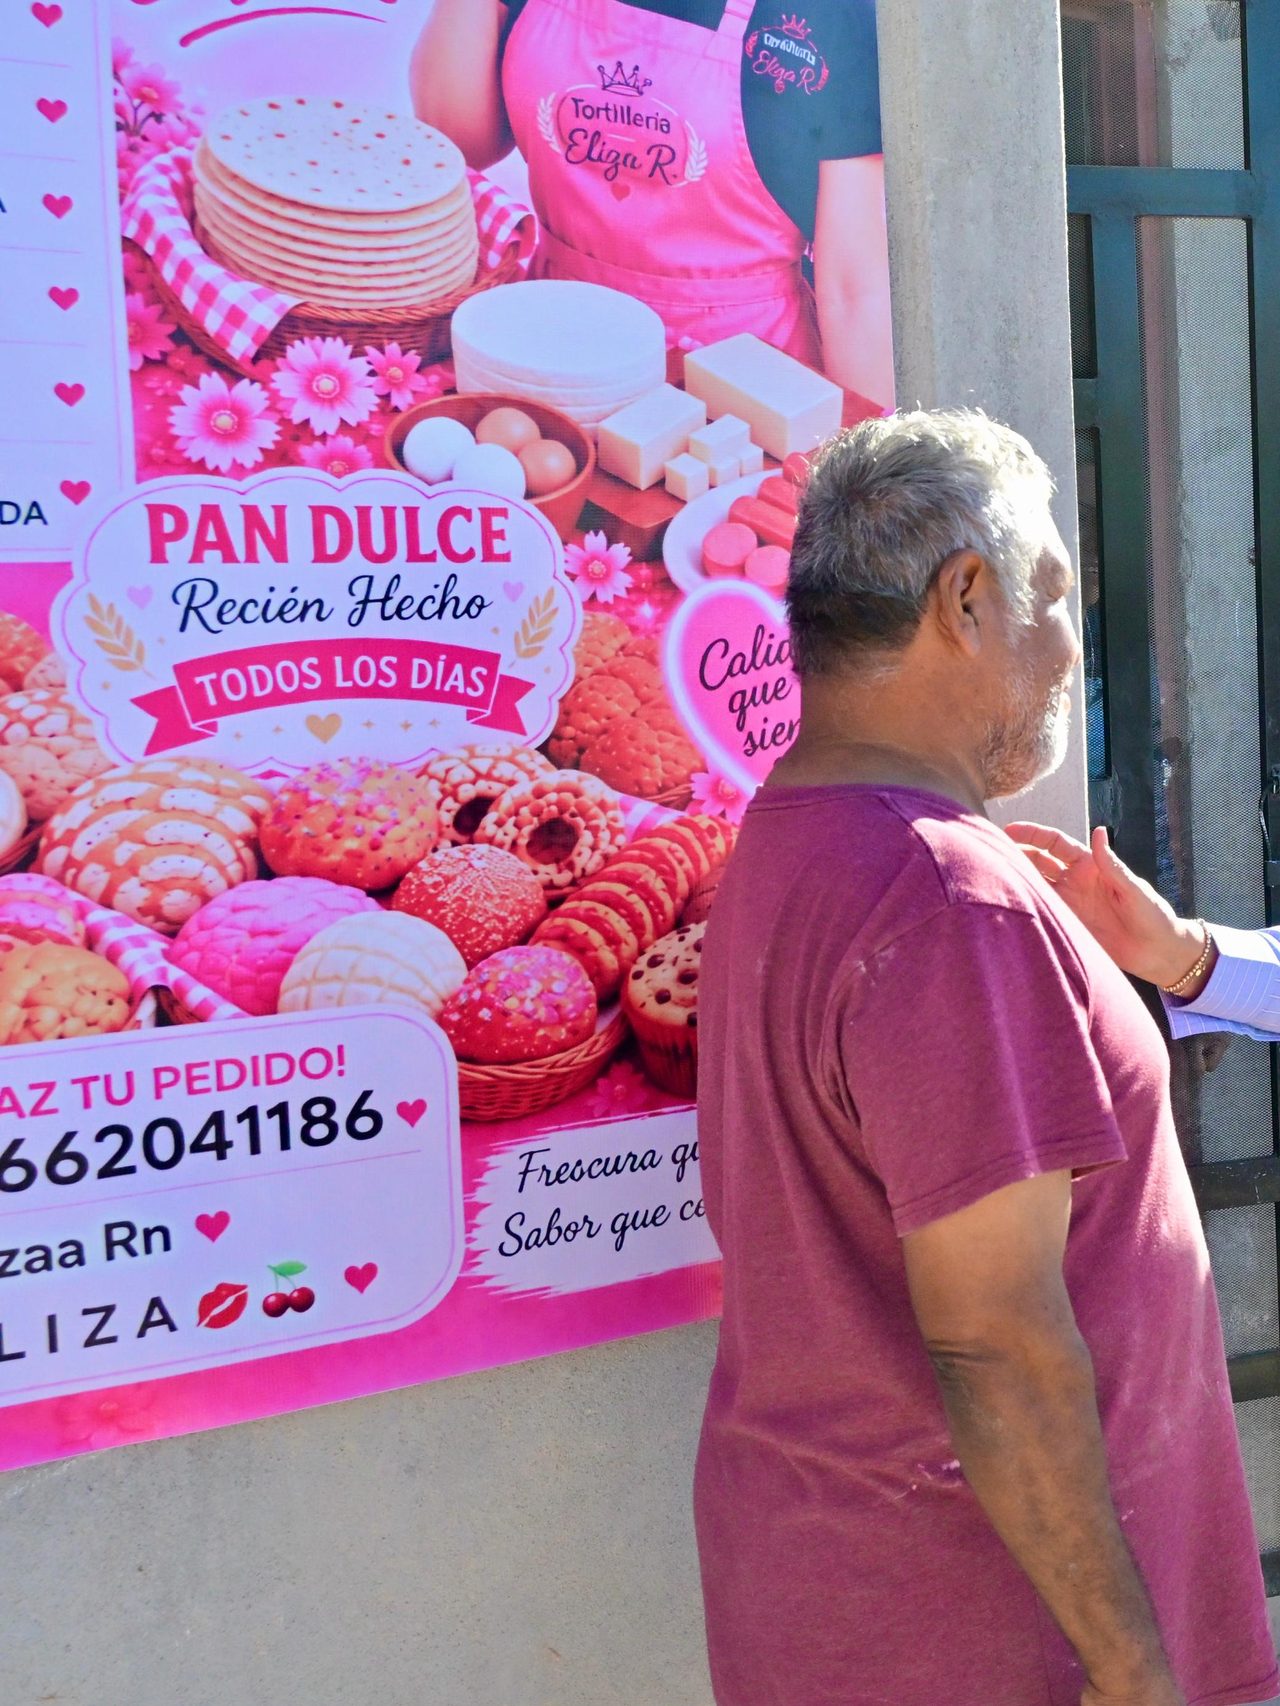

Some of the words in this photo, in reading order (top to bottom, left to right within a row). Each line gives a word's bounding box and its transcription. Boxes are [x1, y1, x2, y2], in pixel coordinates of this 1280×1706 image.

[145, 503, 289, 564] PAN
[307, 504, 512, 564] DULCE
[172, 577, 334, 634] Recién
[347, 572, 494, 627] Hecho
[194, 656, 322, 706] TODOS
[333, 655, 398, 688] LOS
[411, 654, 488, 697] DÍAS
[728, 676, 793, 732] que
[71, 1071, 136, 1109] TU
[153, 1044, 346, 1100] PEDIDO!
[0, 1089, 384, 1193] 662041186
[518, 1148, 662, 1193] Frescura
[104, 1220, 172, 1261] Rn
[498, 1207, 602, 1256] Sabor
[610, 1205, 671, 1251] que
